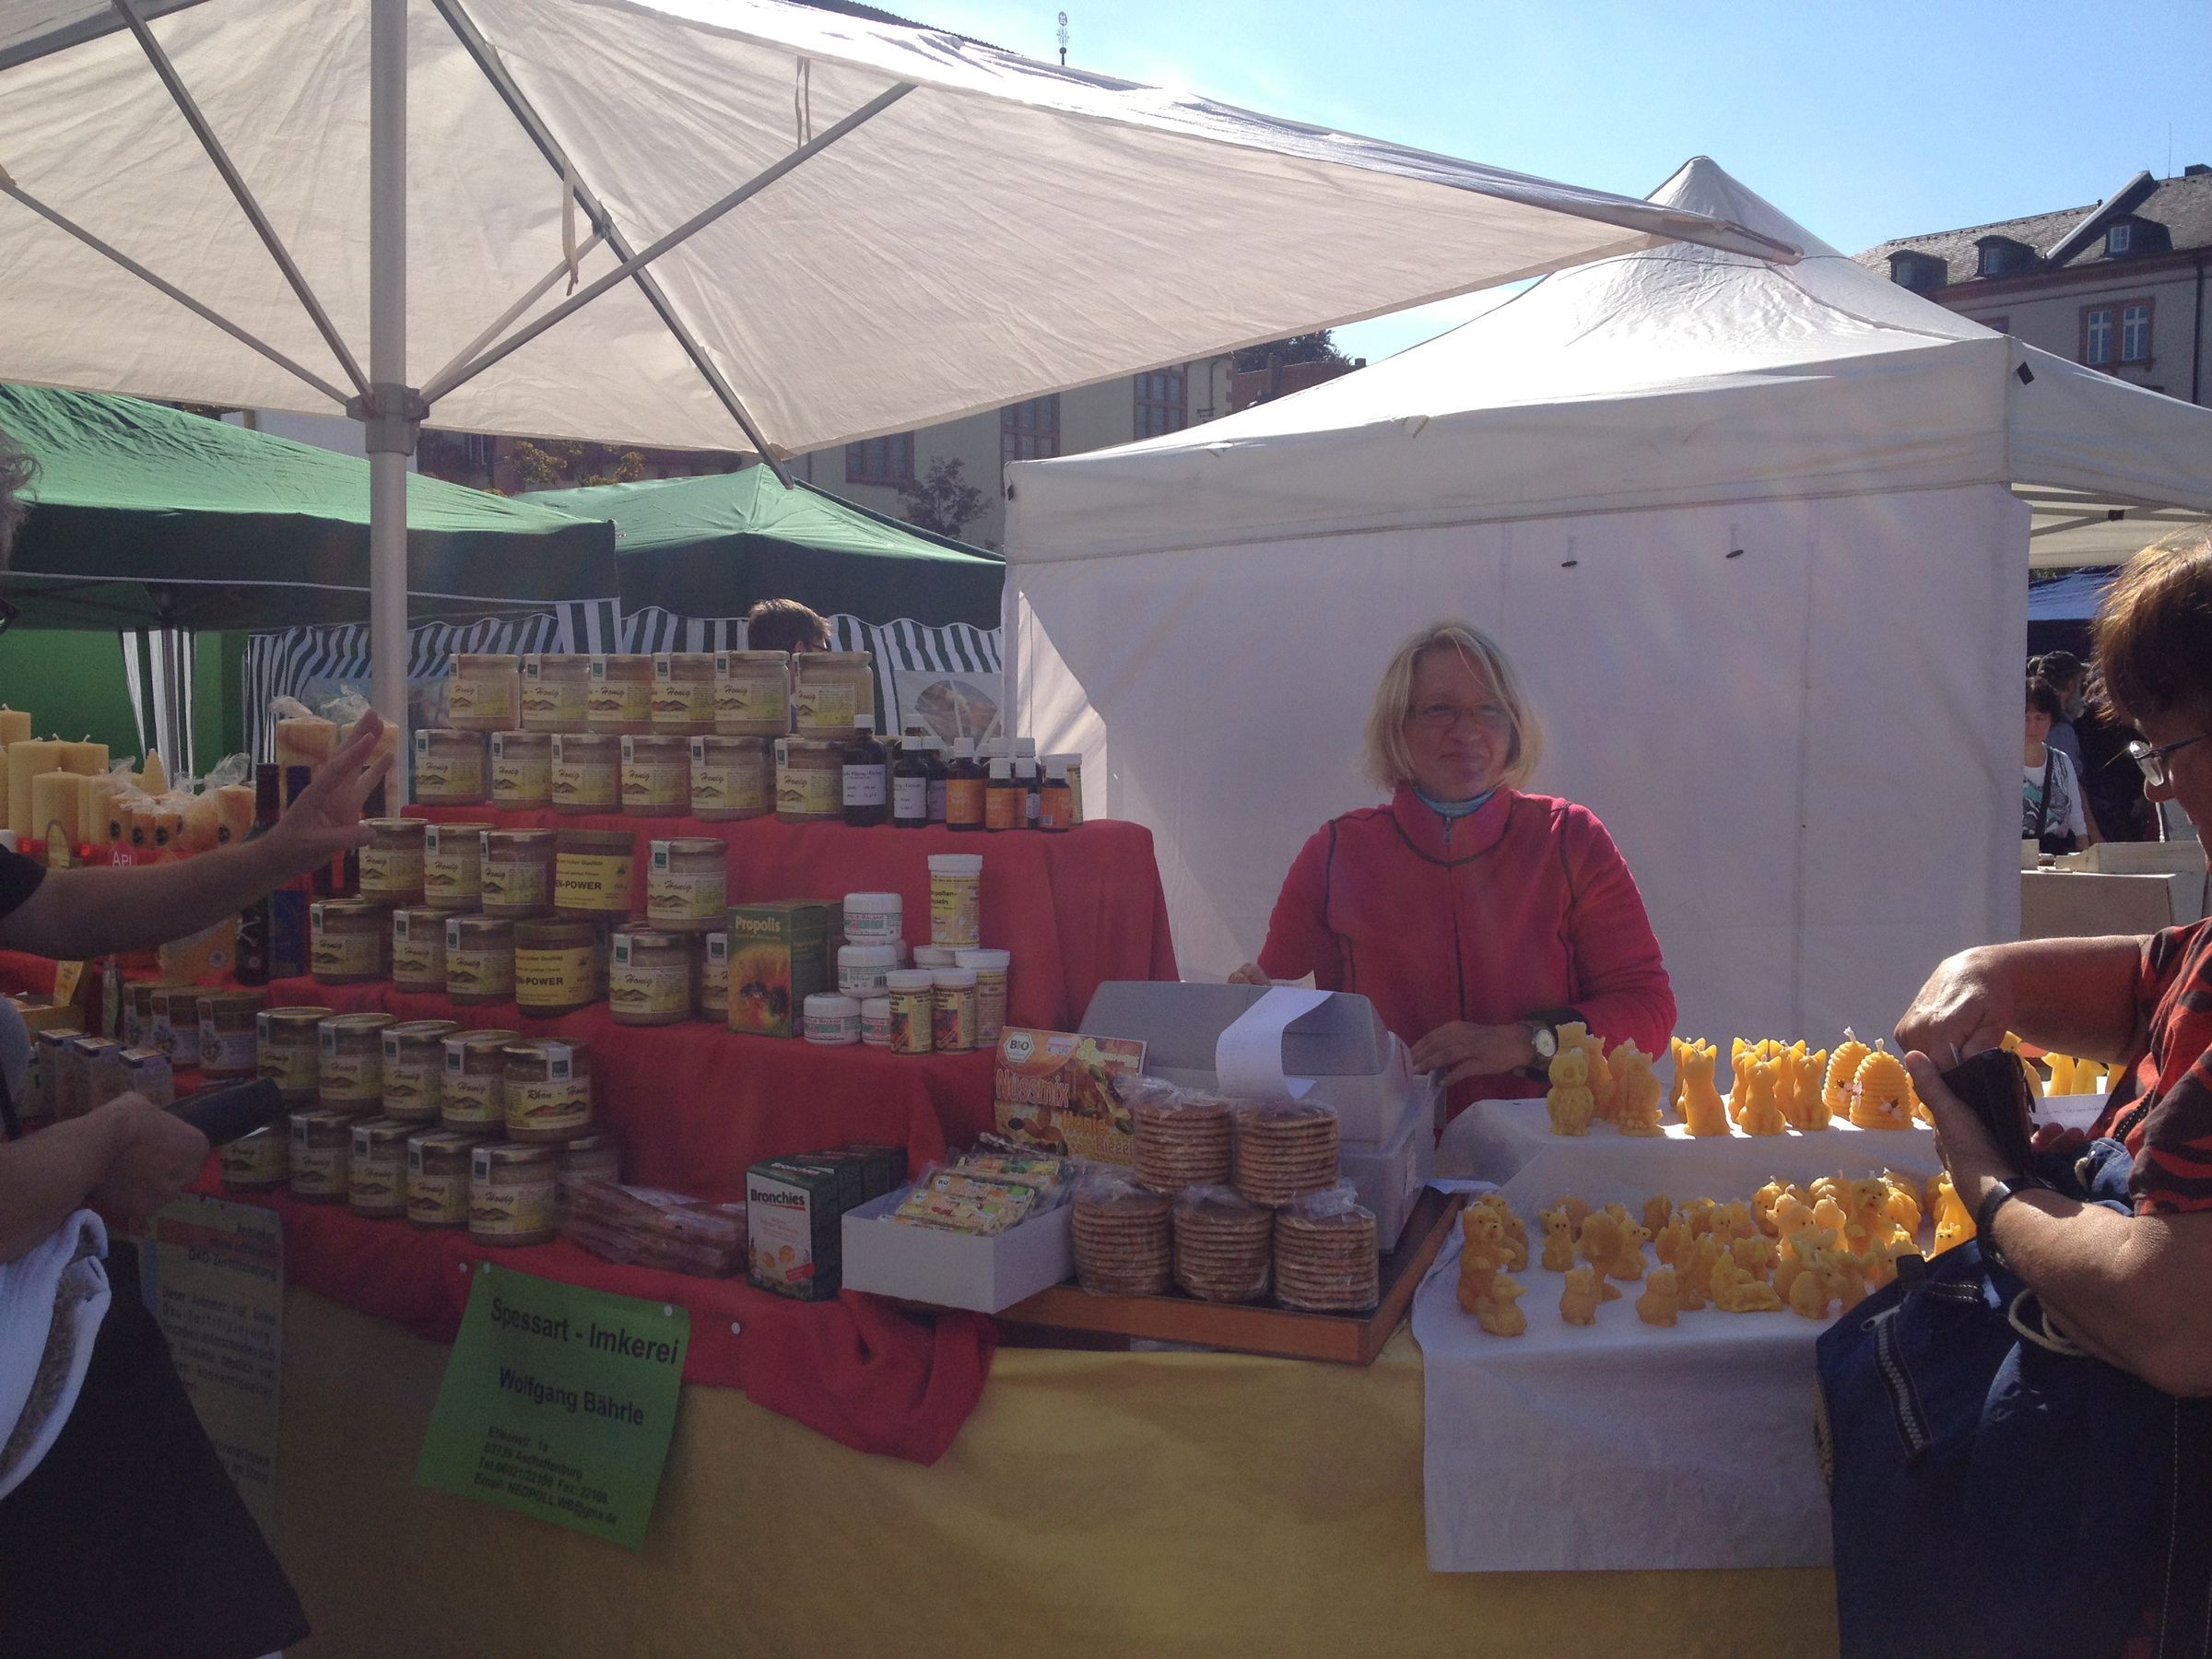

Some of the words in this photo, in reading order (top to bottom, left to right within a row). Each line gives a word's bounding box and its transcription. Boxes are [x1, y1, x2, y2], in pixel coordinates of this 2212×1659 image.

[535, 687, 559, 698] Honig
[601, 686, 625, 697] Honig
[665, 686, 691, 698] Honig
[724, 684, 748, 696] Honig
[499, 766, 519, 777] Honig
[559, 769, 581, 780] Honig
[629, 769, 650, 781] Honig
[700, 772, 724, 784] Honig
[784, 775, 808, 788] Honig
[435, 861, 460, 872] Honig
[485, 867, 506, 879] Honig
[665, 880, 693, 892] Honig
[735, 915, 782, 935] Propolis
[457, 958, 481, 969] Honig
[626, 974, 653, 987] Honig
[327, 1062, 358, 1075] Honig
[456, 1082, 487, 1095] Honig
[995, 1068, 1070, 1108] Nussmix
[526, 1088, 553, 1101] Rhön
[418, 1182, 446, 1194] Honig
[485, 1192, 514, 1205] Honig
[750, 1189, 805, 1205] Bronchies
[490, 1298, 571, 1343] Spessart
[590, 1323, 681, 1366] Imkerei
[500, 1366, 579, 1414] Wolfgang
[583, 1390, 645, 1427] Bährle
[516, 1451, 583, 1481] Aschaffenburg
